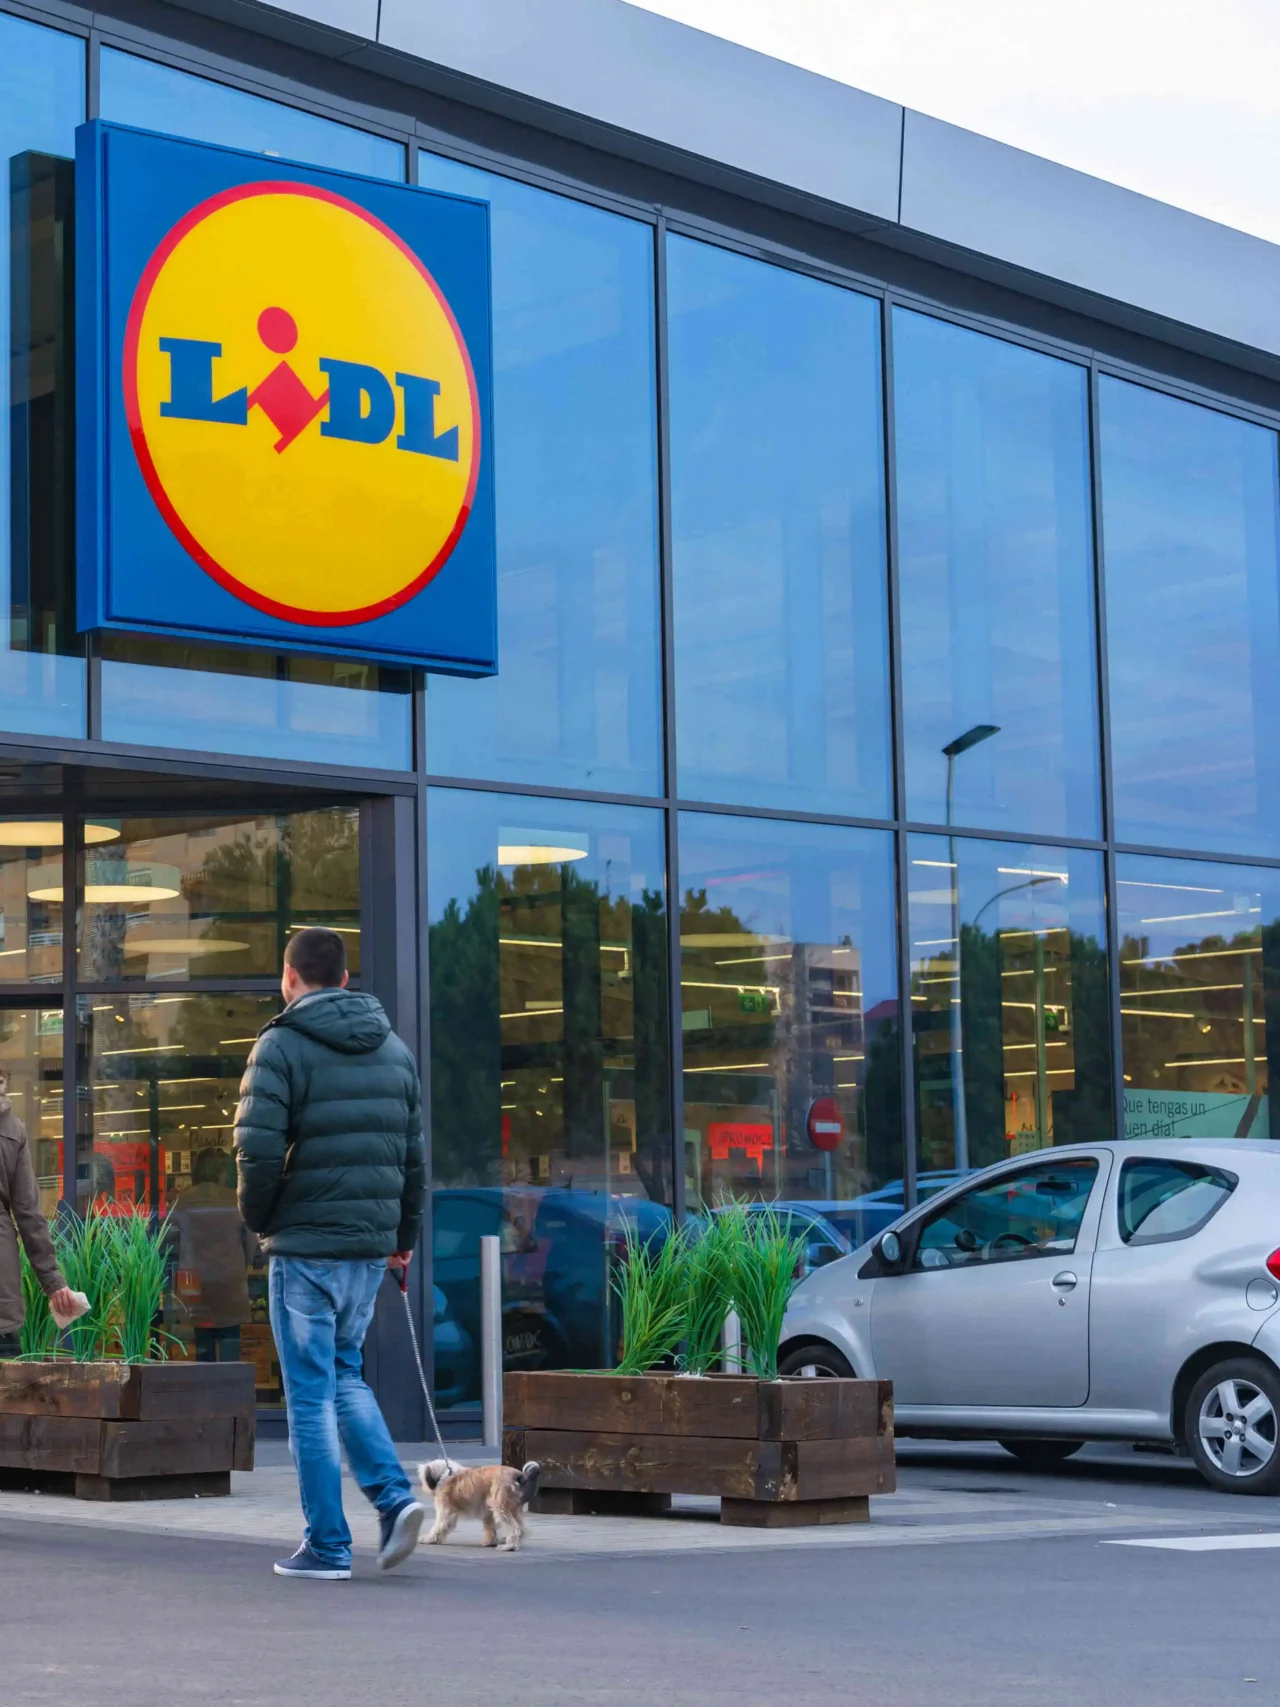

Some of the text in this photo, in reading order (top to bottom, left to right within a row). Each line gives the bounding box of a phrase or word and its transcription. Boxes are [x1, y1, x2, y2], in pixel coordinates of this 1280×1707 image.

[1148, 1097, 1188, 1118] tengas
[1191, 1102, 1206, 1115] un
[1124, 1120, 1175, 1137] uen día!
